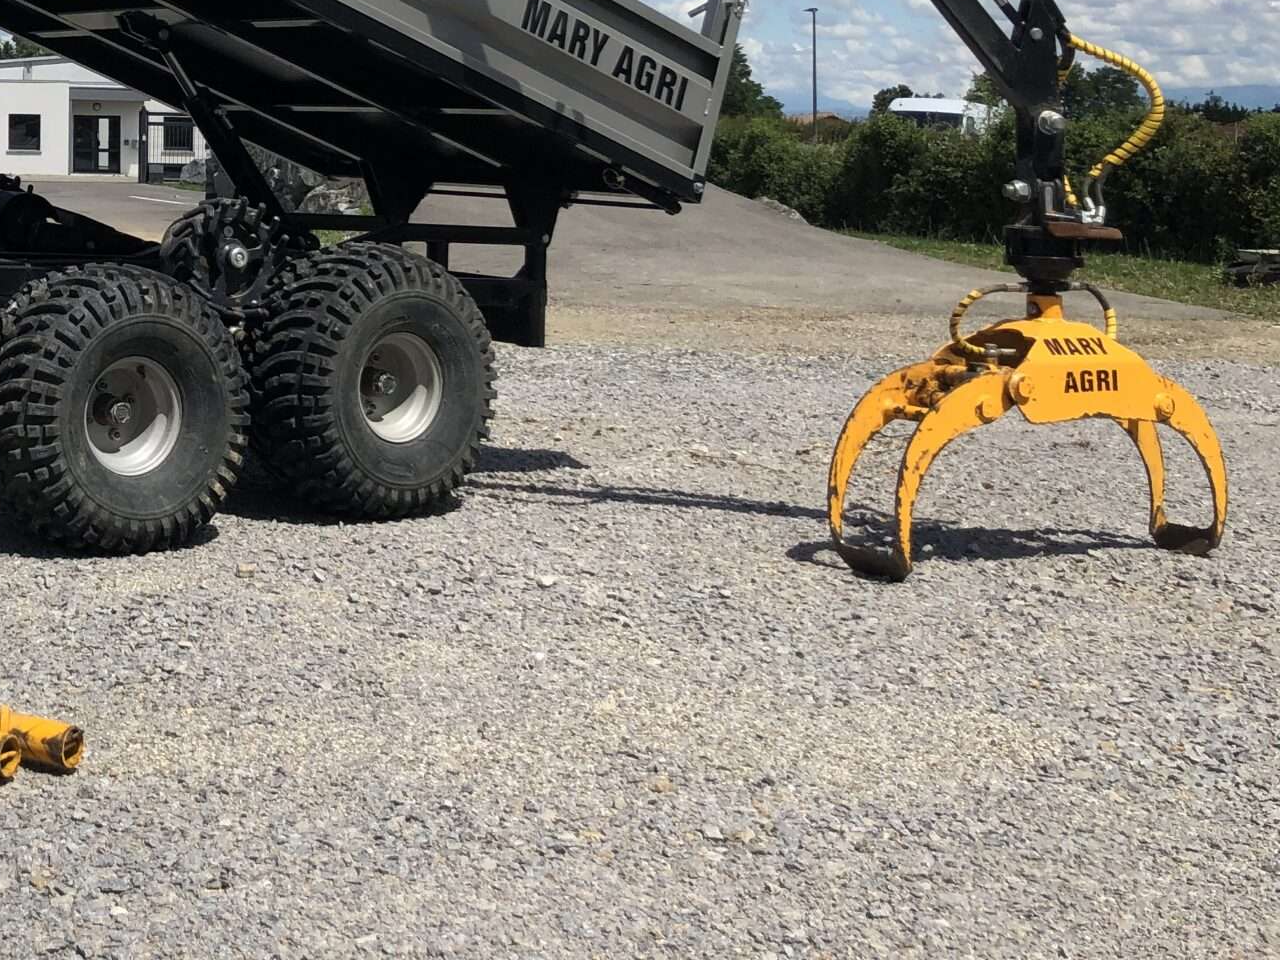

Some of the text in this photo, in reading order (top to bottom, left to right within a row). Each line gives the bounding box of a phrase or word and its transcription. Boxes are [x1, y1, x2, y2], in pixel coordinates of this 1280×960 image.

[612, 44, 689, 111] AGRI
[1043, 337, 1108, 356] MARY
[1064, 369, 1118, 393] AGRI
